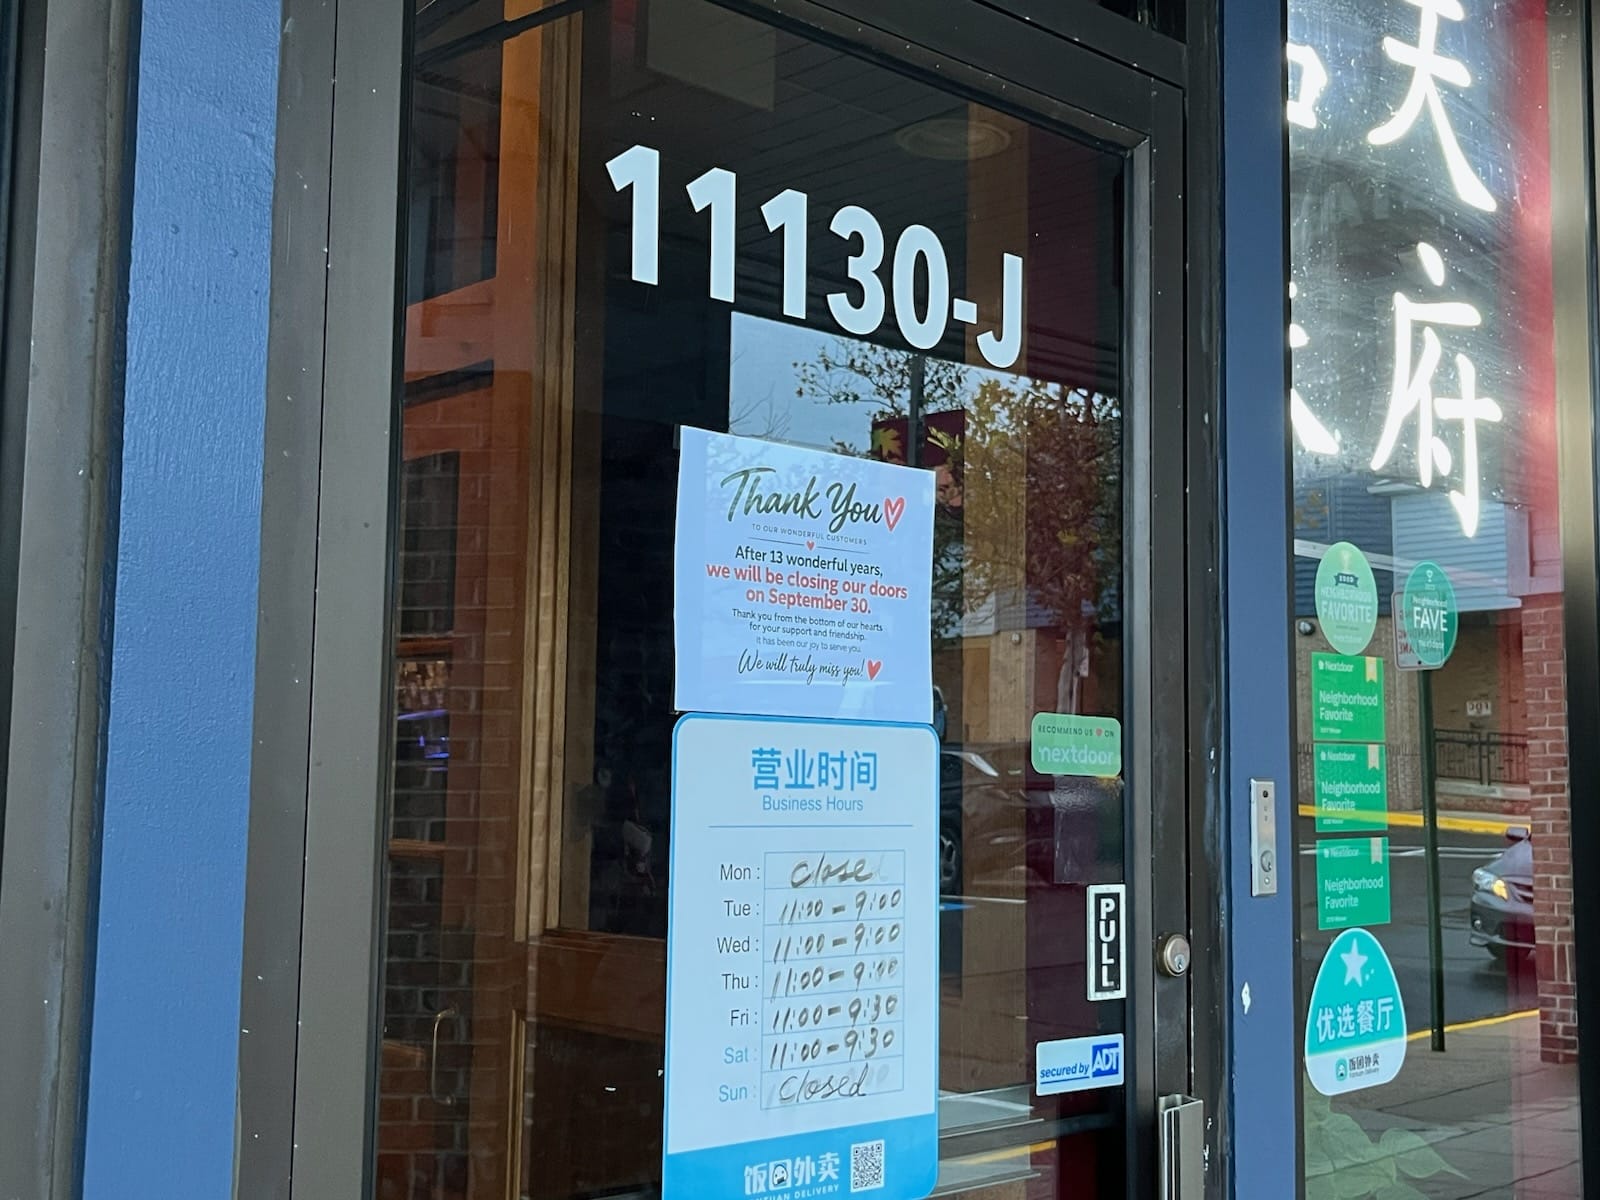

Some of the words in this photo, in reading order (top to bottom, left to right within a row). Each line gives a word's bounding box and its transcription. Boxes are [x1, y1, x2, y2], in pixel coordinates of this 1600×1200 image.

[605, 144, 1023, 369] 11130-J
[720, 467, 822, 522] Thank
[826, 482, 883, 534] You
[752, 523, 761, 532] TO
[763, 525, 779, 534] OUR
[780, 527, 824, 540] WONDERFUL
[826, 533, 868, 546] CUSTOMERS
[735, 546, 767, 562] After
[770, 550, 783, 564] 13
[786, 554, 848, 572] wonderful
[850, 562, 884, 578] years,
[706, 564, 730, 578] we
[733, 564, 762, 583] will
[765, 567, 784, 585] be
[787, 571, 839, 595] closing
[842, 581, 866, 594] our
[869, 581, 909, 599] doors
[746, 589, 765, 602] on
[768, 588, 848, 609] September
[851, 597, 872, 614] 30.
[1321, 600, 1372, 623] FAVORITE
[732, 608, 755, 619] Thank
[757, 612, 773, 621] you
[774, 611, 793, 623] from
[794, 615, 808, 625] the
[808, 617, 836, 628] bottom
[837, 619, 845, 628] of
[749, 621, 761, 631] for
[762, 624, 781, 634] your
[782, 626, 812, 637] support
[813, 628, 828, 637] and
[1413, 606, 1449, 632] FAVE
[763, 636, 776, 646] has
[777, 637, 795, 647] been
[796, 640, 809, 648] our
[809, 641, 820, 651] joy
[821, 642, 829, 650] to
[829, 643, 848, 651] serve
[738, 648, 763, 674] We
[765, 652, 789, 672] will
[790, 654, 817, 685] truly
[819, 662, 841, 677] miss
[842, 659, 866, 686] you!
[1319, 689, 1378, 707] Neighborhood
[1319, 707, 1354, 721] Favorite
[1037, 724, 1083, 736] RECOMMEND
[1084, 728, 1094, 737] US
[1104, 730, 1115, 738] ON
[1038, 744, 1114, 765] nextdoor
[751, 747, 878, 791] 营业时间
[1321, 780, 1380, 797] Neighborhood
[762, 794, 822, 811] Business
[826, 795, 864, 811] Hours
[1321, 798, 1356, 811] Favorite
[1324, 875, 1384, 894] Neighborhood
[778, 899, 823, 926] 11:00
[855, 889, 901, 921] 9:00
[1325, 895, 1359, 910] Favorite
[774, 933, 825, 965] 11:00
[854, 922, 900, 955] 9:00
[1099, 898, 1116, 987] PULL
[770, 966, 824, 1003] 11:00
[853, 956, 898, 992] 9:00
[773, 1004, 823, 1033] 11:00
[848, 994, 898, 1027] 9:30
[1316, 997, 1394, 1043] 优选餐厅
[770, 1038, 821, 1071] 11:00
[844, 1027, 895, 1062] 9:30
[1040, 1063, 1078, 1078] secured
[1079, 1061, 1090, 1075] by
[1092, 1047, 1119, 1072] ADT
[794, 1184, 840, 1199] DELIVERY
